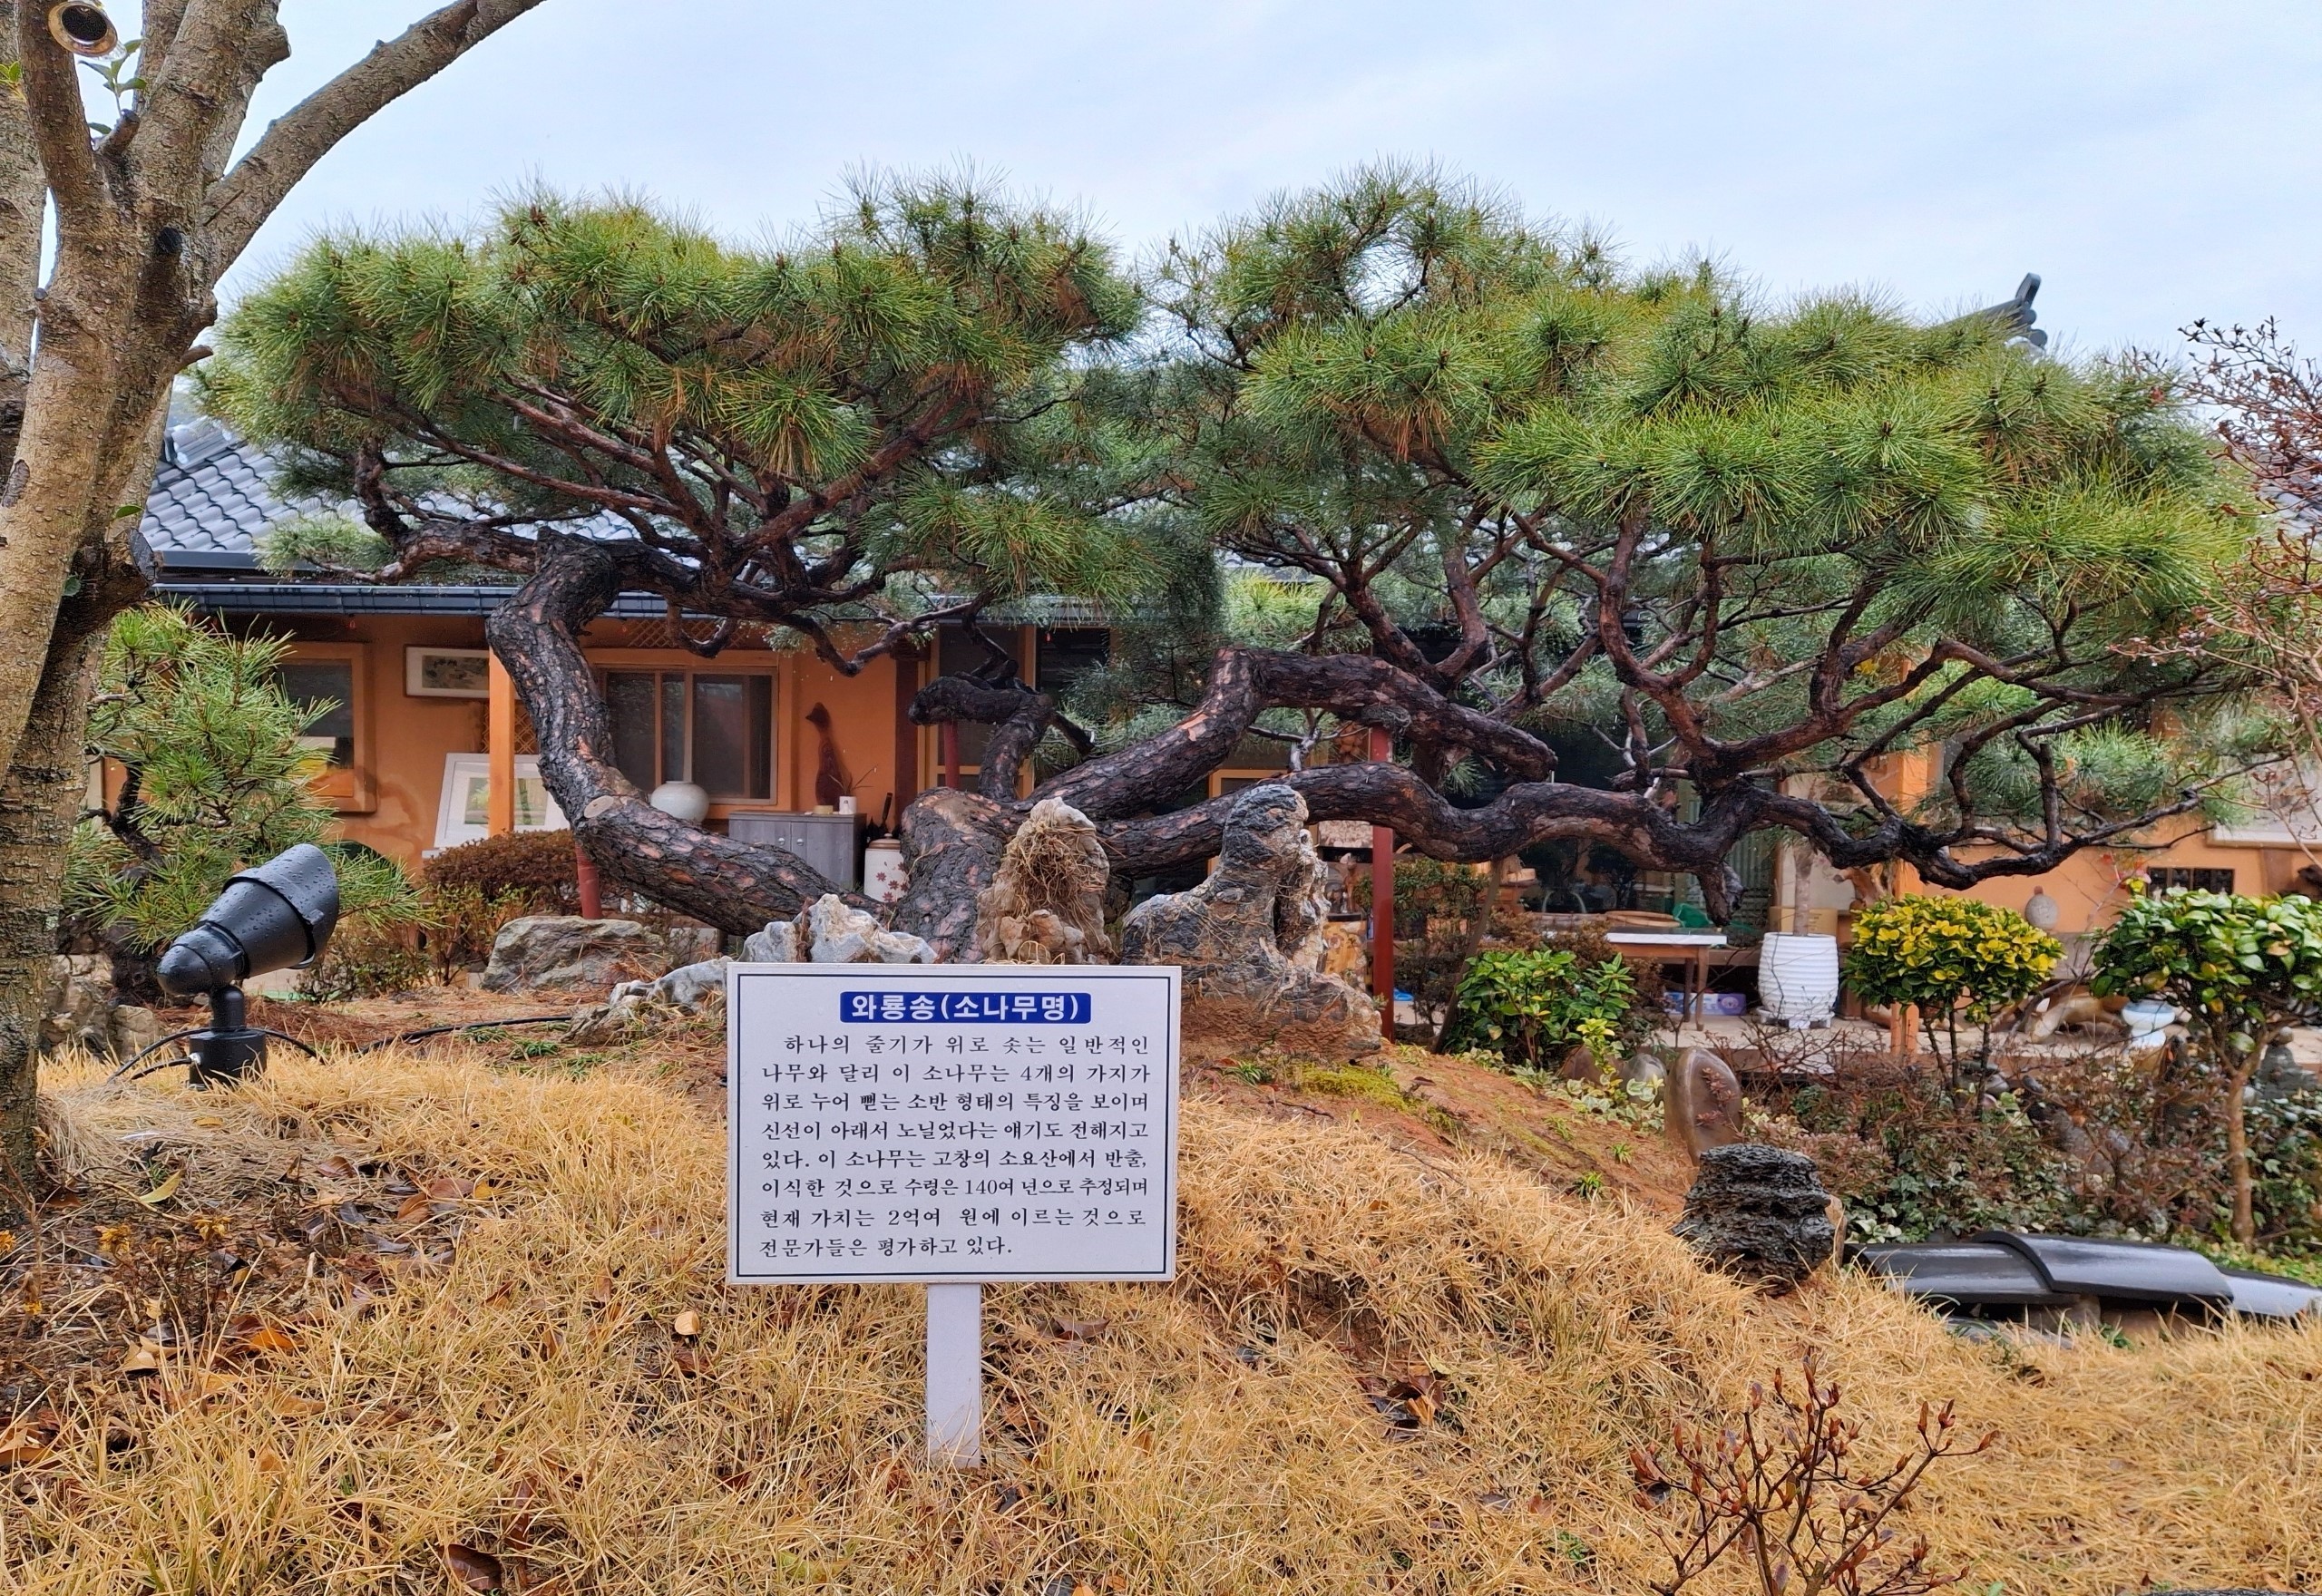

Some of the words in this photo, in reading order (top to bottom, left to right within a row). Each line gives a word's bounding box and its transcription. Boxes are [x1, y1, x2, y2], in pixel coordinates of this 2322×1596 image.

[851, 994, 1080, 1022] 와룡송(소나무명)
[784, 1035, 849, 1055] 하나의
[865, 1035, 933, 1055] 줄기가
[945, 1035, 990, 1055] 위로
[1002, 1036, 1046, 1055] 솟는
[1059, 1035, 1148, 1056] 일반적인
[762, 1063, 828, 1084] 나무와
[838, 1063, 879, 1084] 달리
[893, 1063, 909, 1084] 이
[922, 1063, 1010, 1084] 소나무는
[1020, 1064, 1074, 1084] 4개의
[1087, 1064, 1151, 1084] 가지가
[762, 1092, 804, 1113] 위로
[810, 1092, 849, 1112] 누어
[859, 1092, 901, 1112] 뻗는
[906, 1092, 948, 1112] 소반
[955, 1092, 1013, 1112] 형태의
[1022, 1092, 1084, 1112] 특징을
[1090, 1092, 1147, 1112] 보이며
[761, 1121, 821, 1141] 신선이
[830, 1120, 888, 1141] 아래서
[896, 1120, 998, 1141] 노닐었다는
[1069, 1120, 1149, 1141] 전해지고
[762, 1149, 810, 1170] 있다.
[818, 1149, 835, 1170] 이
[844, 1149, 926, 1169] 소나무는
[932, 1148, 990, 1169] 고창의
[999, 1148, 1095, 1169] 소요산에서
[1105, 1148, 1146, 1168] 반출,
[762, 1178, 825, 1199] 이식한
[834, 1178, 898, 1198] 것으로
[904, 1178, 959, 1197] 수령은
[965, 1177, 1014, 1197] 140여
[1021, 1177, 1075, 1196] 년으로
[1078, 1177, 1147, 1197] 추정되며
[760, 1209, 800, 1229] 현재
[811, 1208, 875, 1229] 가치는
[888, 1207, 940, 1228] 2억여
[959, 1207, 1000, 1227] 원에
[1010, 1207, 1074, 1227] 이르는
[1082, 1207, 1146, 1227] 것으로
[759, 1238, 868, 1258] 전문가들은
[877, 1236, 958, 1257] 평가하고
[966, 1235, 1012, 1256] 있다.
